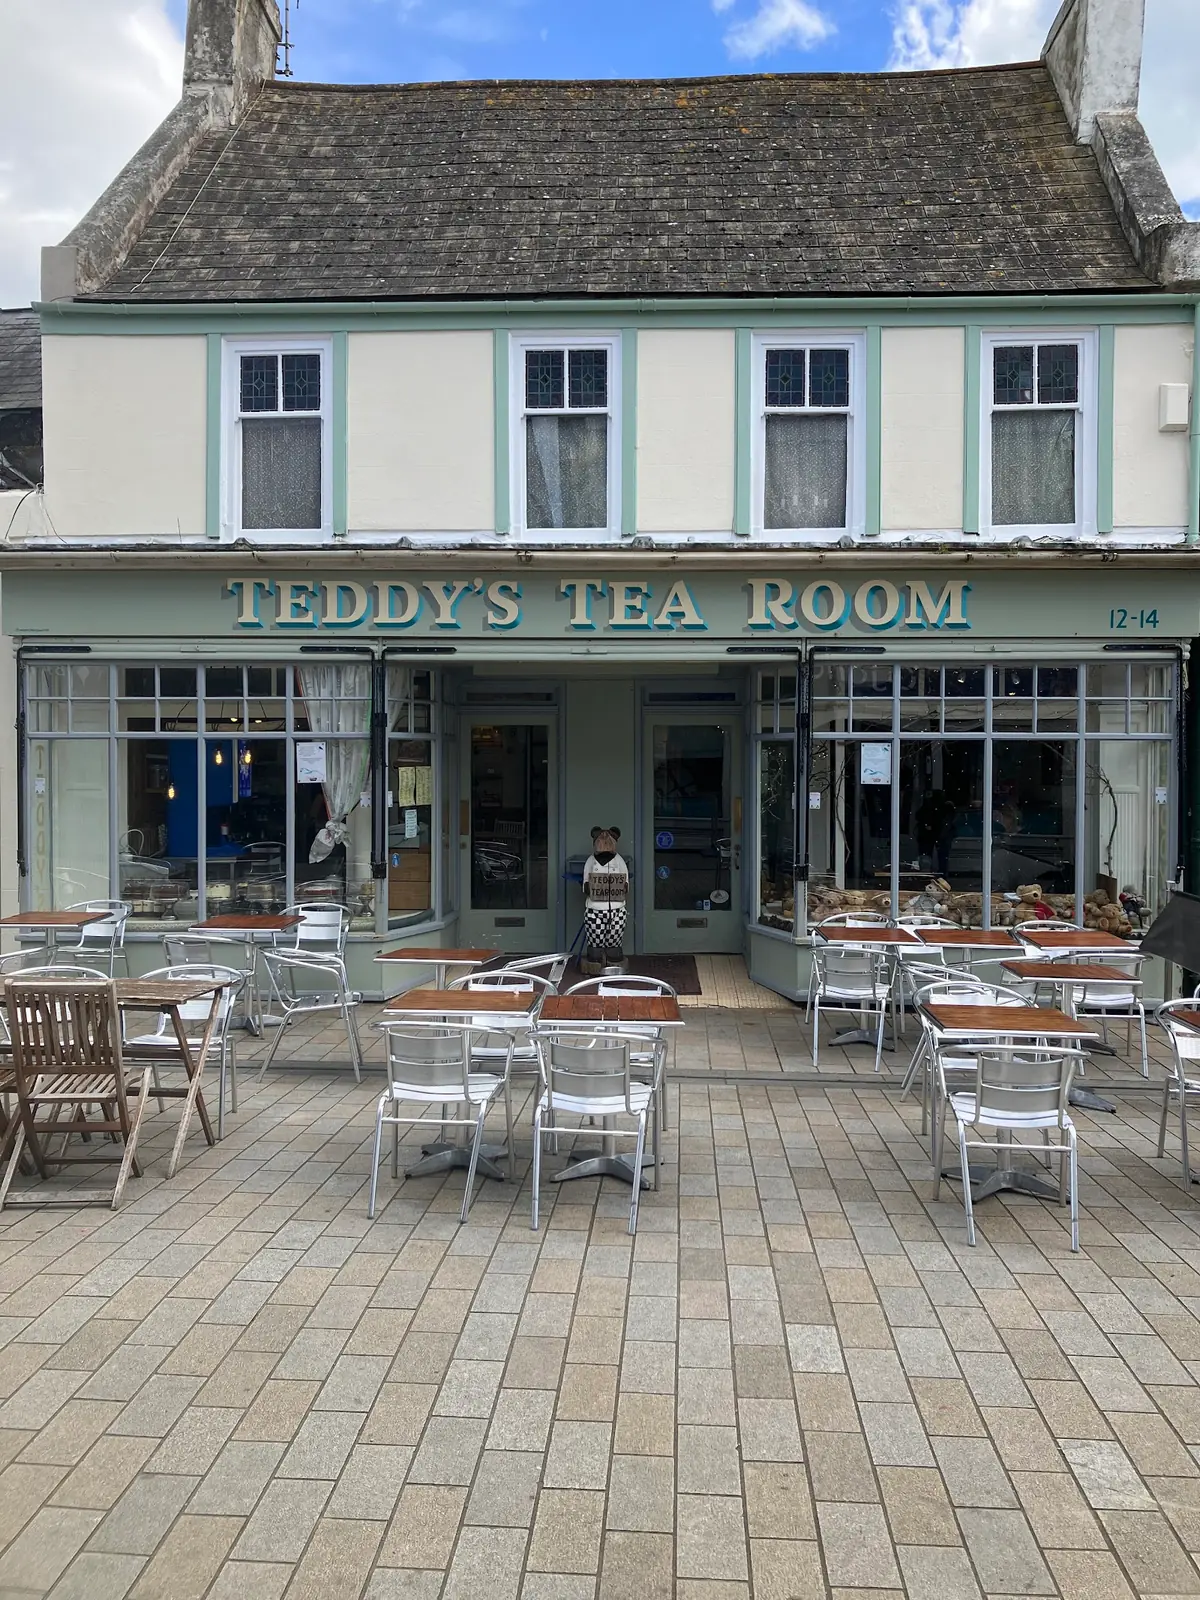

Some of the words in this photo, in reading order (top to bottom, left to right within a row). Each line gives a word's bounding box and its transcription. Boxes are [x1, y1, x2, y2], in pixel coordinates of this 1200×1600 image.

[226, 577, 522, 630] TEDDY'S
[559, 578, 707, 630] TEA
[746, 578, 971, 630] ROOM
[1110, 608, 1160, 629] 12-14
[592, 874, 625, 884] TEDDY'S
